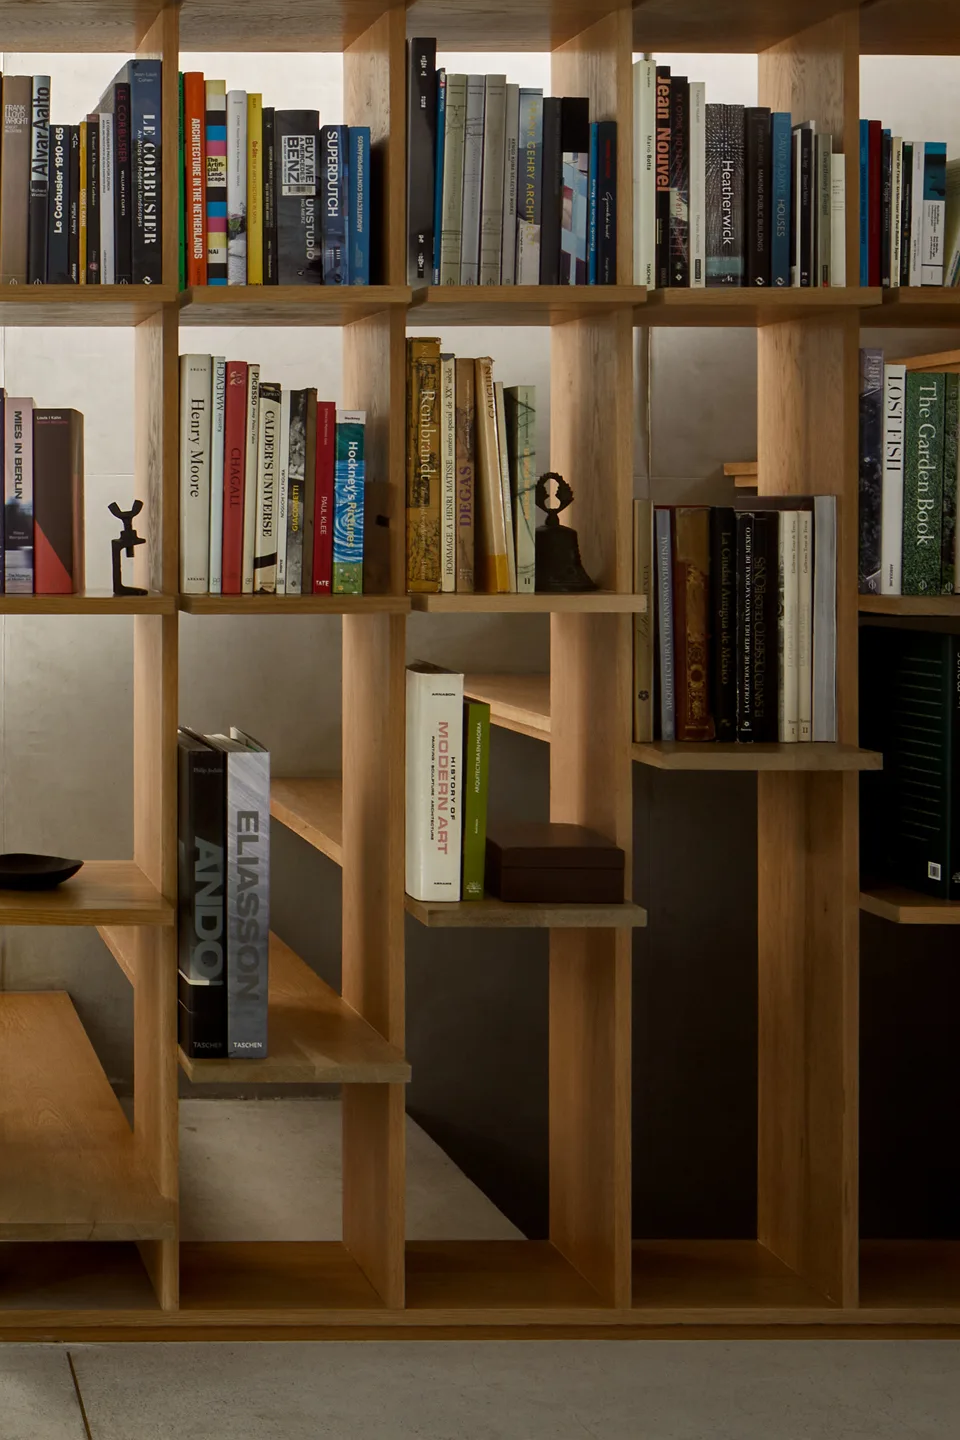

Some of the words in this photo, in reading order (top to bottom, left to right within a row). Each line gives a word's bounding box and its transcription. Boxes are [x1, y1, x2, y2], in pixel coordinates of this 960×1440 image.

[32, 87, 49, 131] Aalto
[117, 89, 126, 100] LE
[657, 76, 671, 119] Jean
[5, 117, 28, 125] WRIGHT
[117, 105, 127, 162] CORBUSIER
[138, 130, 143, 138] An
[143, 114, 155, 136] LE
[32, 132, 49, 176] Alvar
[138, 156, 143, 164] of
[192, 118, 200, 176] ARCHITECTURE
[288, 137, 298, 183] BENZ
[305, 137, 313, 161] BUY
[527, 141, 536, 179] GEHRY
[657, 128, 671, 191] Nouvel
[54, 170, 63, 218] Corbusier
[144, 143, 156, 244] CORBUSIER
[193, 178, 201, 186] IN
[193, 187, 201, 202] THE
[306, 165, 314, 182] ME
[327, 131, 338, 217] SUPERDUTCH
[524, 183, 535, 246] ARCHITECT
[722, 160, 734, 244] Heatherwick
[54, 220, 62, 233] Le
[193, 204, 202, 259] NETHERLANDS
[306, 199, 314, 260] UNSTUDIO
[217, 361, 225, 411] MALEVICH
[484, 366, 495, 419] GAUGUIN
[887, 375, 903, 419] LOST
[918, 381, 938, 417] The
[14, 411, 22, 440] MIES
[190, 399, 205, 446] Henry
[264, 410, 274, 469] CALDER'S
[420, 389, 437, 480] Rembrandt
[15, 443, 22, 454] IN
[347, 441, 358, 500] Hockney's
[886, 424, 901, 471] FISH
[917, 423, 936, 492] Garden
[190, 450, 204, 498] Moore
[230, 448, 241, 508] CHAGALL
[459, 466, 472, 527] DEGAS
[263, 471, 274, 537] UNIVERSE
[347, 502, 358, 548] Pictures
[916, 499, 934, 547] Book
[661, 534, 670, 581] VIRREINAL
[722, 532, 731, 542] La
[745, 555, 751, 564] DE
[721, 546, 731, 585] Ciudad
[662, 581, 672, 635] URBANISMO
[719, 588, 731, 628] Antigua
[721, 632, 729, 644] de
[744, 655, 750, 664] DE
[664, 643, 673, 711] ARQUITECTURA
[744, 705, 750, 713] LA
[438, 722, 448, 811] MODERN
[437, 816, 448, 854] ART
[193, 836, 224, 983] ANDO
[235, 810, 260, 1001] ELIASSON
